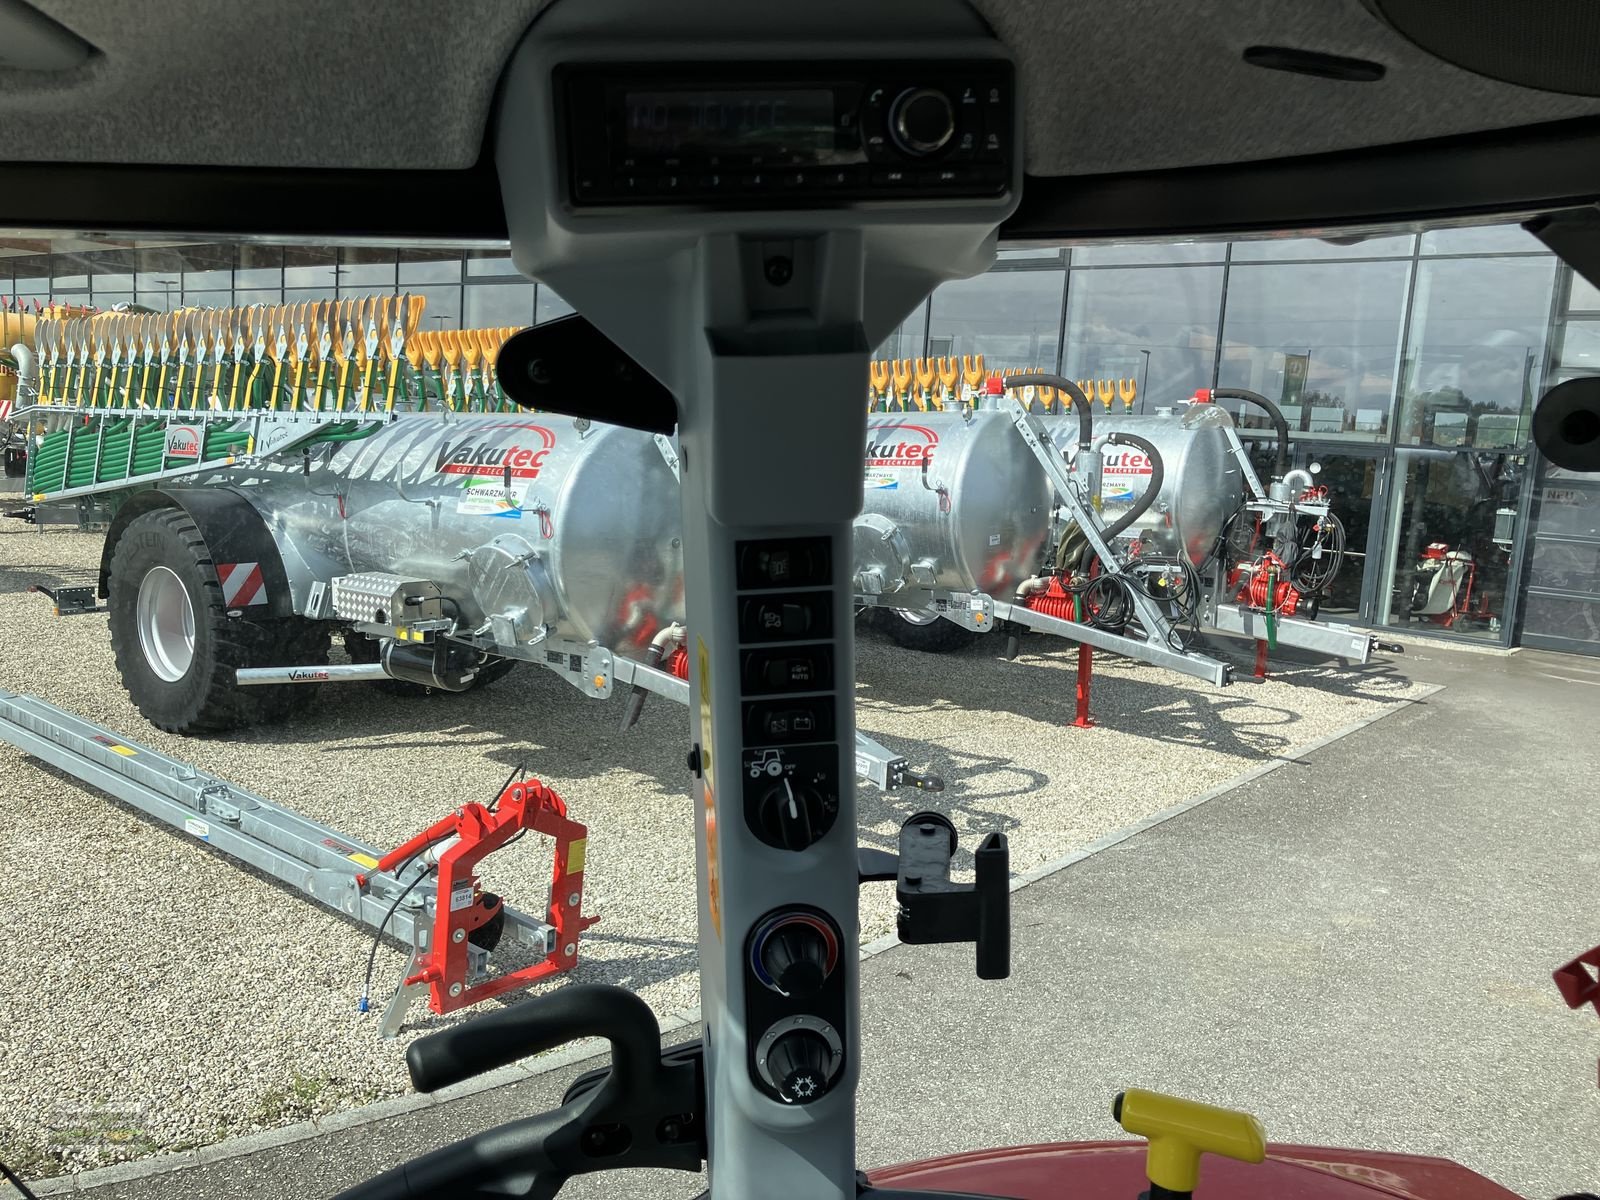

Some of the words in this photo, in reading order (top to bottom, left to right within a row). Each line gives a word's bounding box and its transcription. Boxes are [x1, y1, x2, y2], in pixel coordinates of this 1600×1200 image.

[168, 435, 198, 454] Vakutec
[865, 441, 937, 459] kutec
[435, 435, 550, 473] Vakutec
[466, 487, 517, 498] SCHWARZMR
[288, 669, 329, 680] Vakutec
